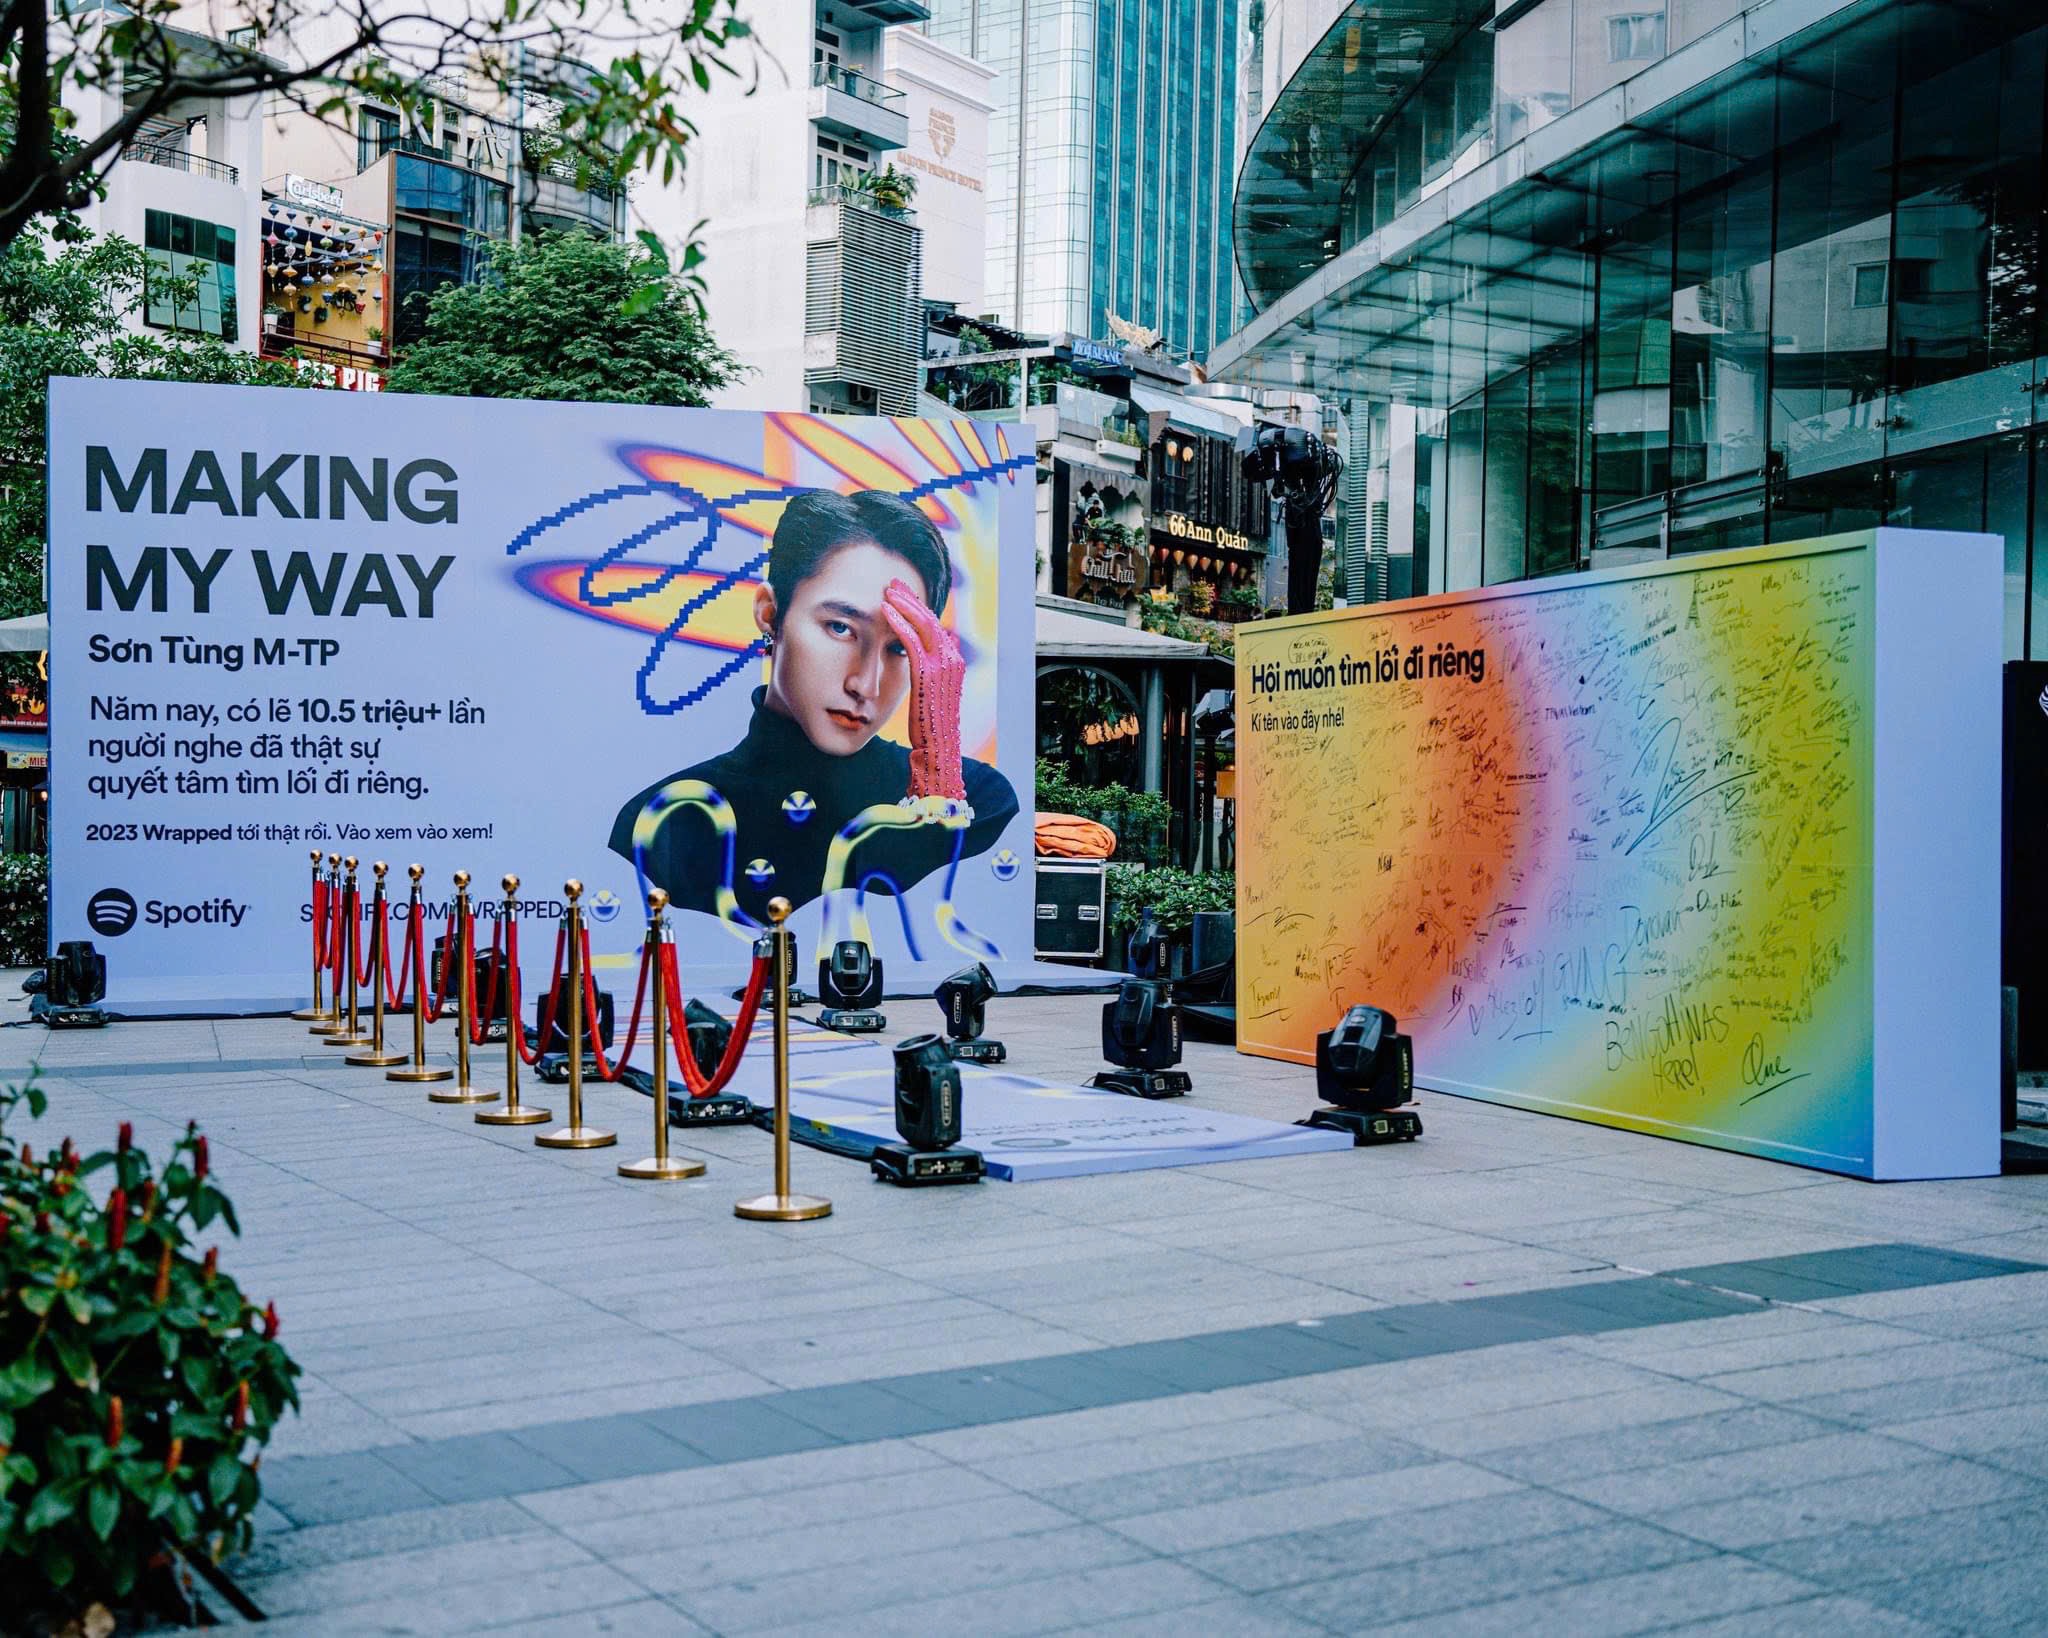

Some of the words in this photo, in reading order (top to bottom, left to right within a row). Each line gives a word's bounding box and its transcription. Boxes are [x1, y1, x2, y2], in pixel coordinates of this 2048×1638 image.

[287, 174, 343, 215] Carlsberg
[86, 445, 459, 525] MAKING
[1169, 514, 1186, 537] 66
[1186, 520, 1213, 543] Ann
[1216, 526, 1249, 551] Quán
[86, 545, 233, 614] MY
[251, 550, 457, 619] WAY
[89, 634, 152, 664] Sơn
[160, 636, 243, 671] Tùng
[253, 638, 339, 666] M-TP
[1252, 661, 1280, 702] Hội
[1285, 651, 1335, 691] muốn
[1339, 653, 1371, 686] tìm
[1376, 643, 1399, 683] lối
[1404, 644, 1423, 680] đi
[1428, 642, 1484, 684] riêng
[91, 695, 157, 721] Năm
[167, 703, 219, 727] nay,
[227, 698, 260, 722] có
[270, 697, 291, 722] lẽ
[298, 699, 355, 724] 10.5
[362, 698, 442, 730] triệu+
[449, 696, 486, 724] lần
[1251, 712, 1261, 732] Kí
[1263, 711, 1278, 731] tên
[1281, 709, 1299, 730] vào
[1301, 708, 1320, 733] đây
[1322, 706, 1345, 728] nhé!
[29, 756, 48, 767] MIE
[89, 732, 166, 763] người
[175, 734, 242, 764] nghe
[250, 734, 283, 759] đã
[291, 734, 343, 764] thật
[351, 737, 381, 764] sự
[88, 766, 168, 800] quyết
[174, 770, 229, 794] tâm
[235, 770, 279, 794] tìm
[287, 767, 317, 794] lối
[325, 770, 349, 794] đi
[357, 770, 429, 800] riêng.
[87, 824, 138, 841] 2023
[143, 824, 232, 845] Wrapped
[237, 823, 259, 841] tới
[264, 823, 299, 845] thật
[305, 821, 332, 841] rồi.
[336, 823, 370, 840] Vào
[376, 828, 411, 840] xem
[416, 824, 447, 840] vào
[453, 824, 493, 840] xem!
[145, 898, 247, 928] Spotify
